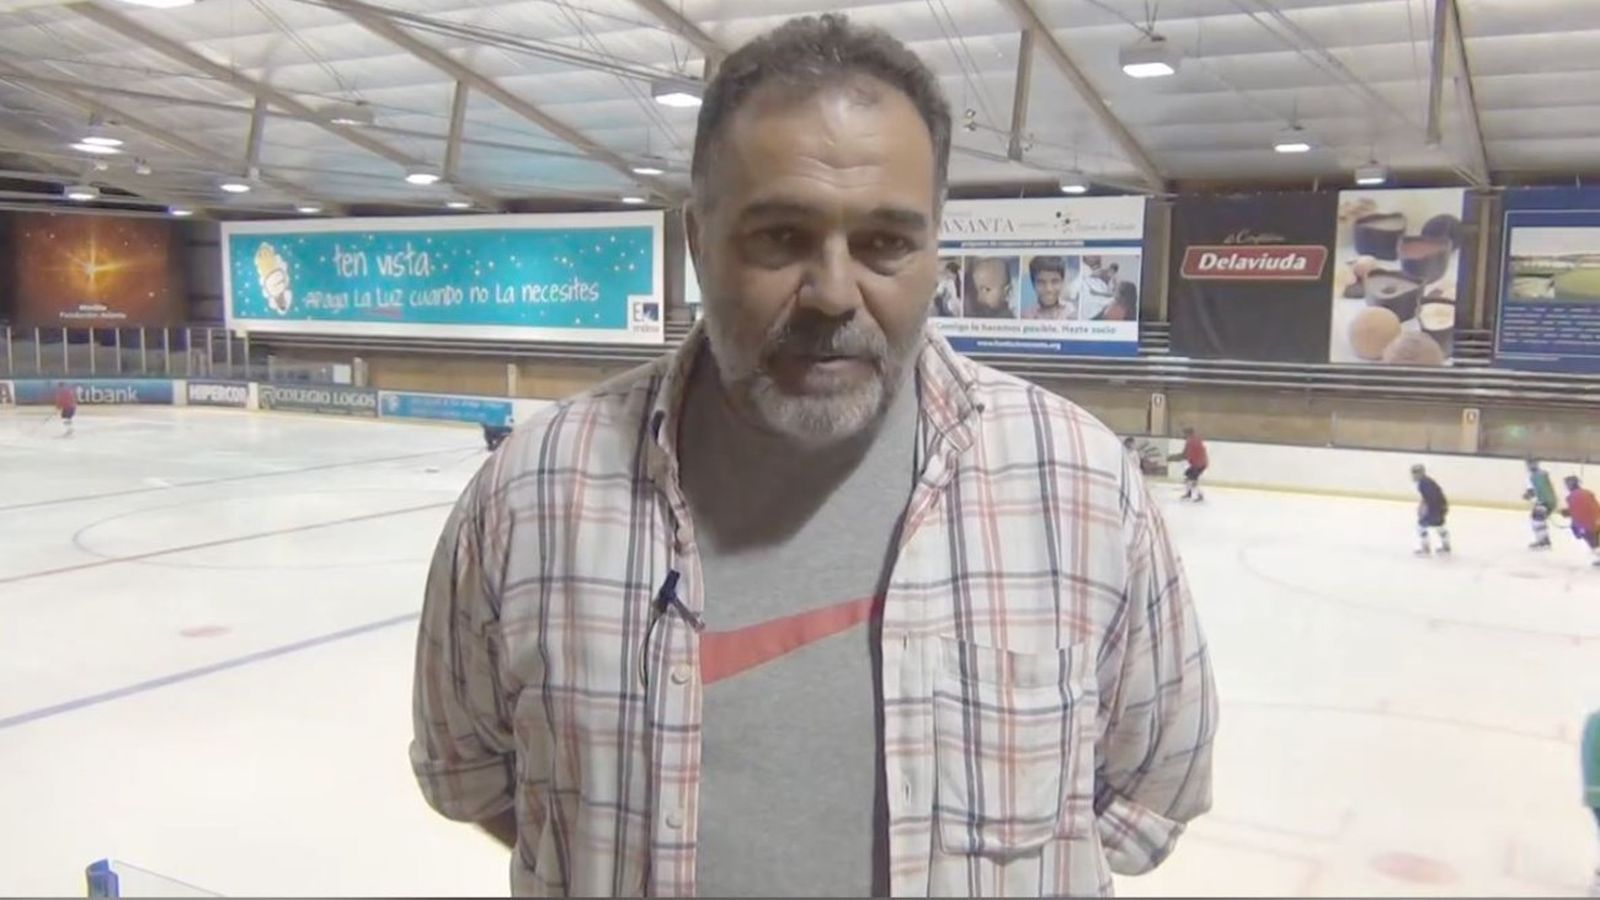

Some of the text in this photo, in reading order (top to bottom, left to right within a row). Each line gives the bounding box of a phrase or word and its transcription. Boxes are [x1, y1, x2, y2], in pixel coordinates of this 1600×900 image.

[333, 241, 430, 277] ten vista
[1198, 252, 1307, 270] Delaviuda
[469, 285, 489, 303] no
[522, 277, 599, 302] necesites
[75, 385, 139, 403] tibank
[276, 387, 377, 408] COLEGIO LOGOS
